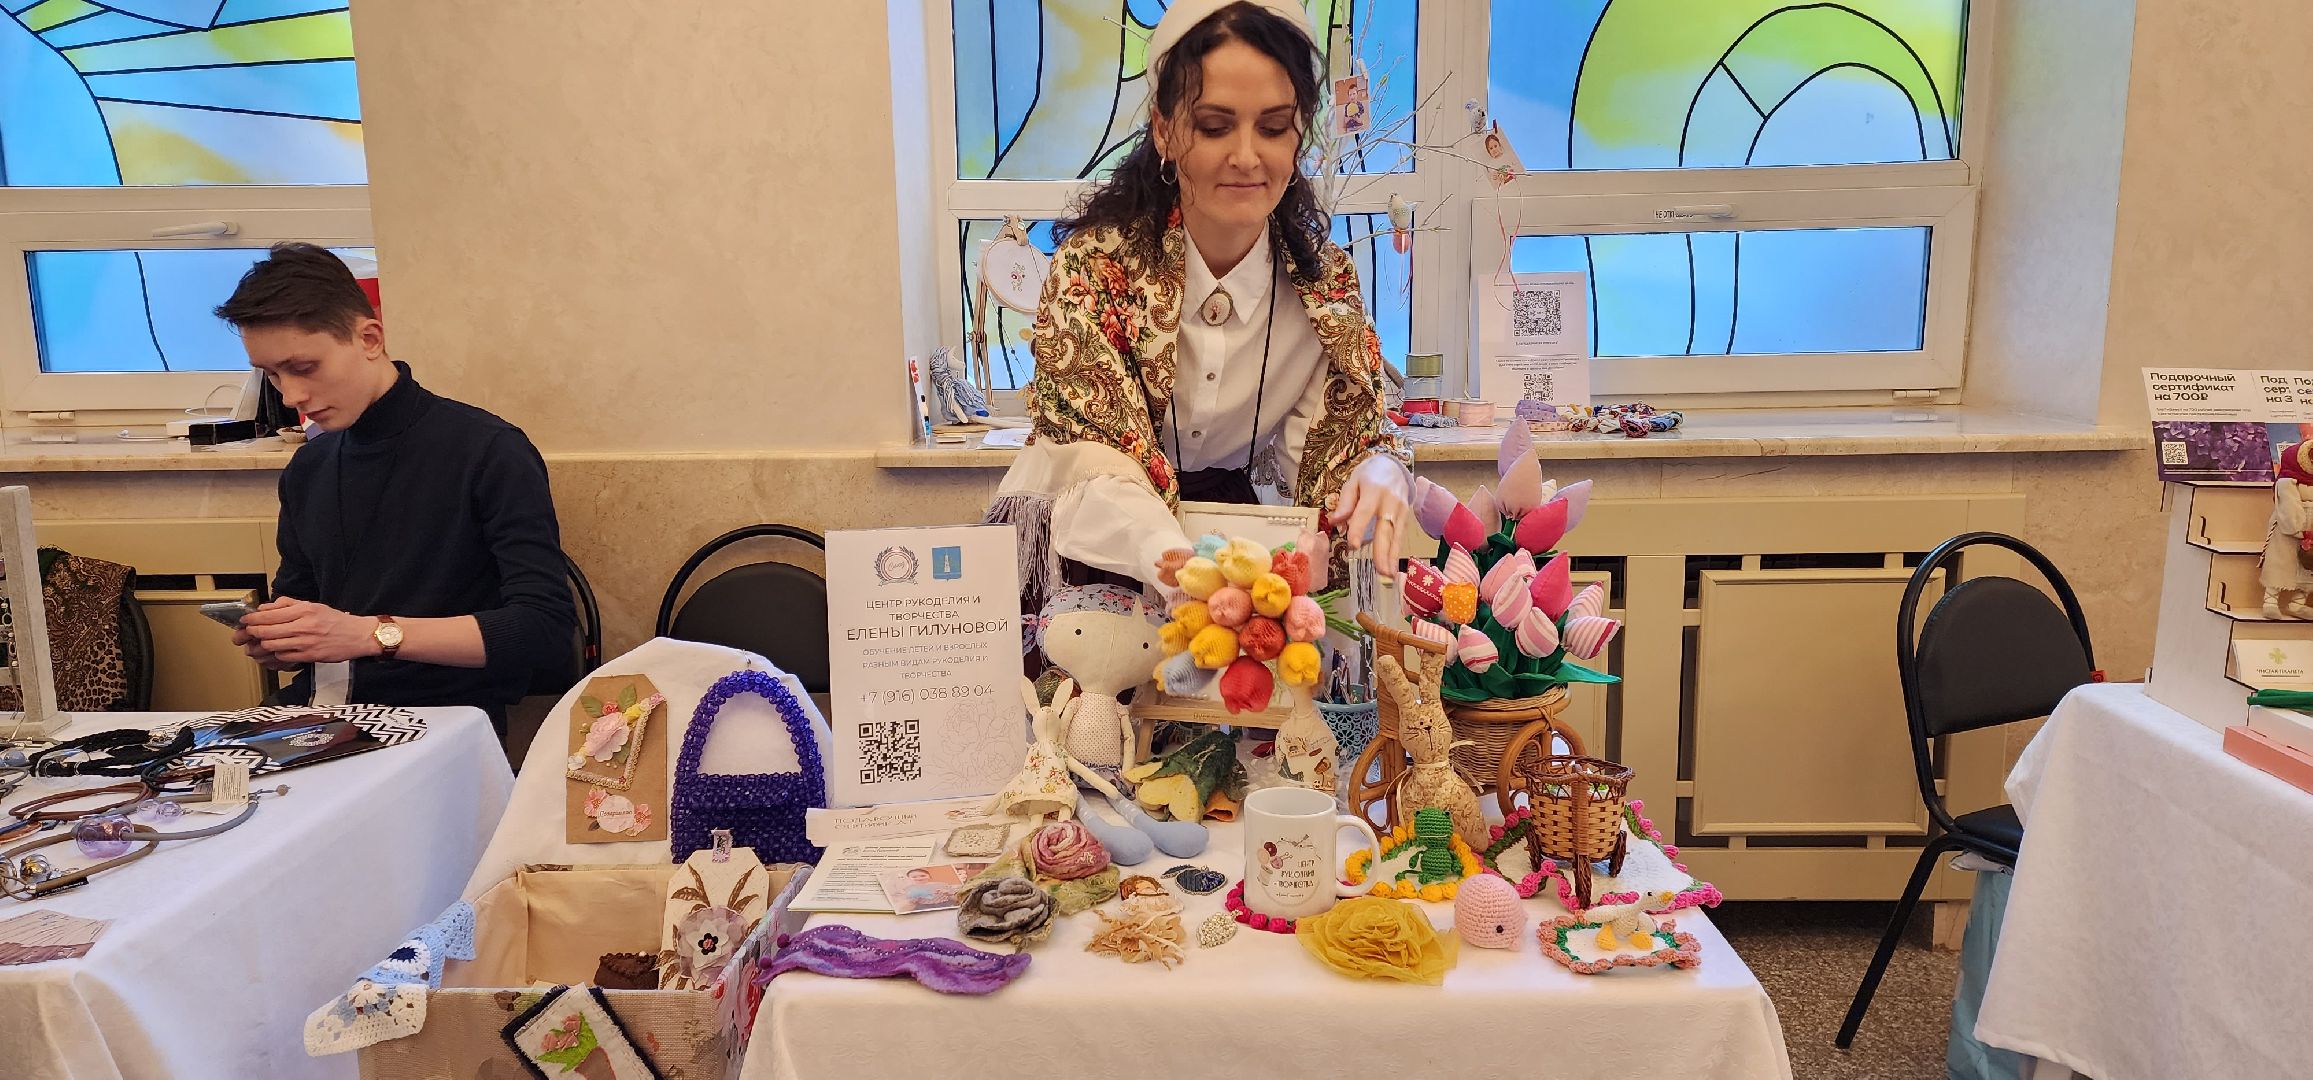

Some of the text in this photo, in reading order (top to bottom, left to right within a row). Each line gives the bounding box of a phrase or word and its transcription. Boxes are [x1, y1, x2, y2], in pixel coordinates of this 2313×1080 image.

[2150, 372, 2236, 383] Подарочный
[2152, 383, 2236, 393] сертификат
[2154, 393, 2171, 401] на
[866, 595, 981, 610] ЦЕНТР РУКОДЕЛИЯ И
[889, 611, 959, 621] ТВОРЧЕСТВА
[847, 618, 1009, 641] ЕЛЕНЫ ГИЛУНОВОЙ
[863, 648, 907, 656] ОБУЧЕНИЕ
[943, 642, 988, 651] ВЗРОСЛЫХ
[863, 660, 899, 669] РАЗНЫМ
[900, 658, 930, 667] ВИДАМ
[932, 655, 981, 665] РУКОДЕЛИЯ
[901, 670, 952, 680] ТВОРЧЕСТВА
[860, 683, 995, 705] +7 (916) 038 89 04
